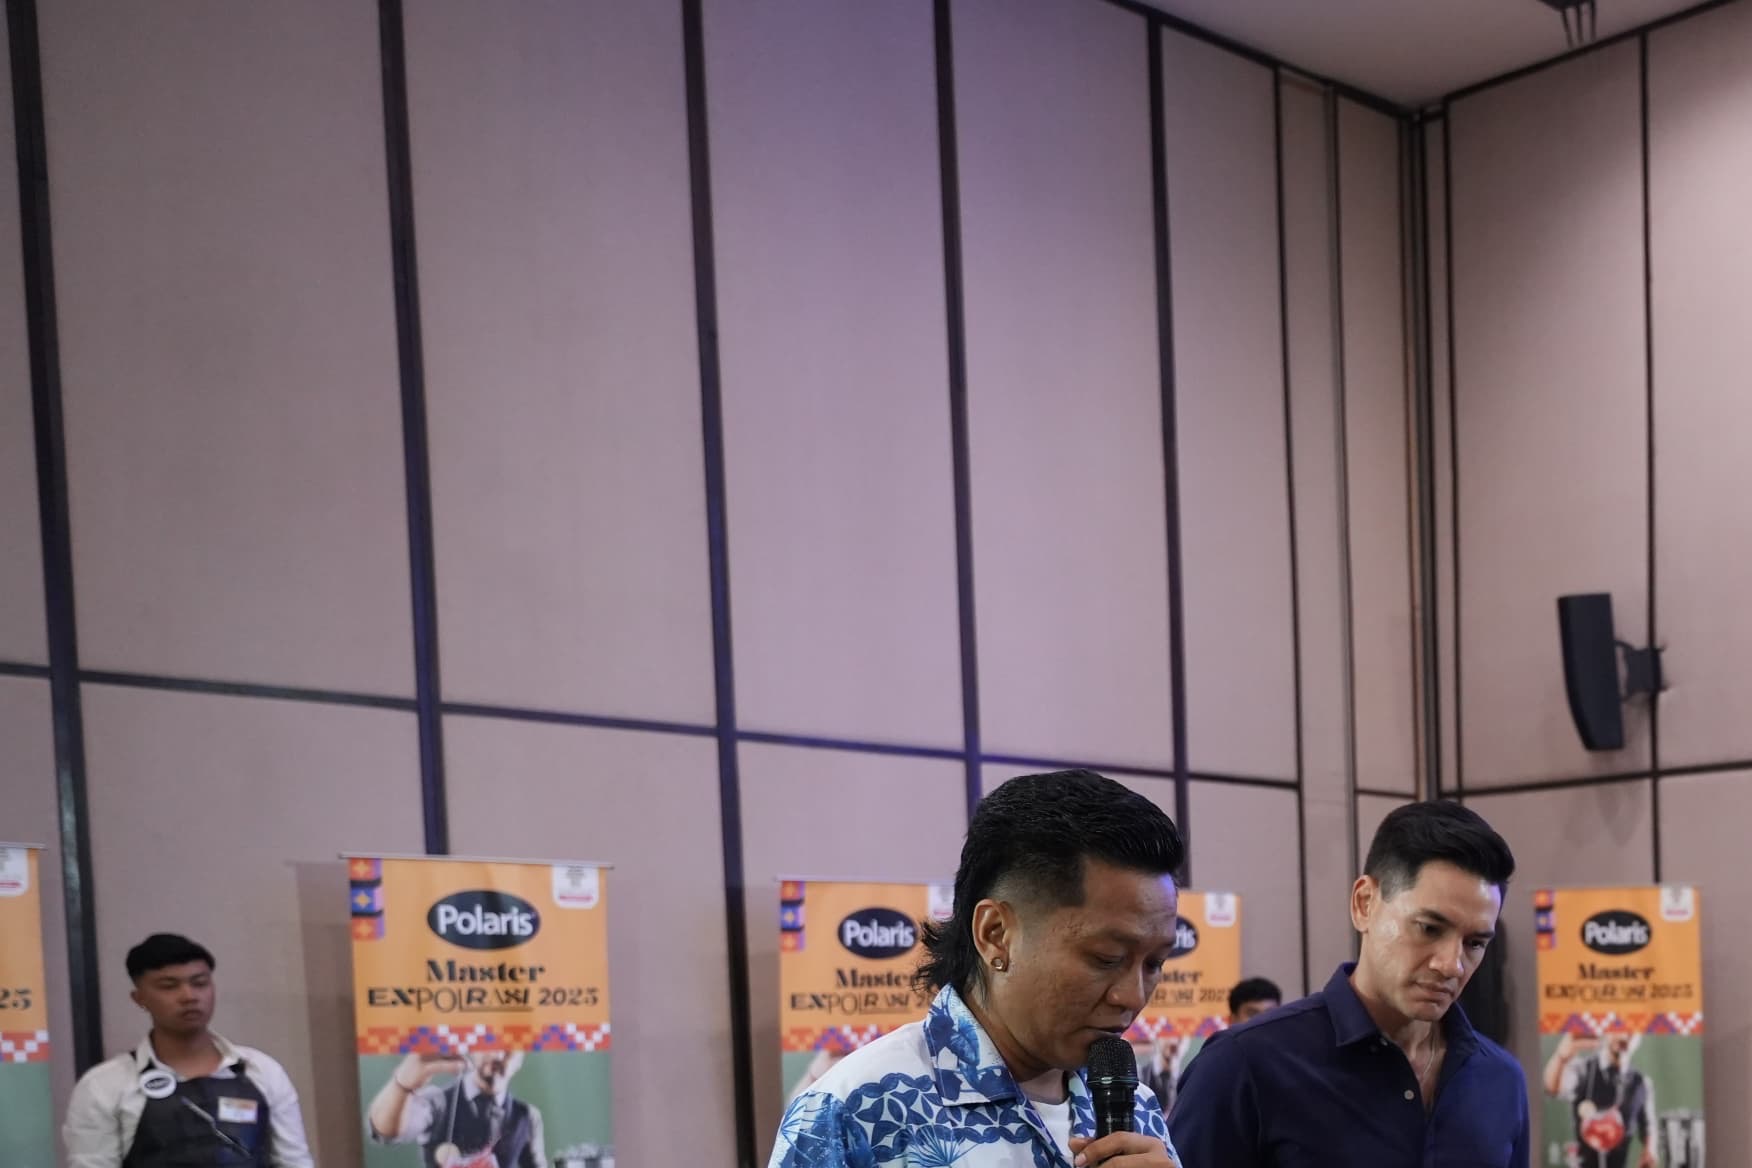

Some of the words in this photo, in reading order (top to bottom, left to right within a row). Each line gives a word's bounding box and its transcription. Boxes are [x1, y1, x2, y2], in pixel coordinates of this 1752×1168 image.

[437, 903, 534, 935] Polaris
[843, 919, 914, 947] Polaris
[1584, 918, 1649, 946] Polaris
[427, 959, 545, 983] Master
[1579, 963, 1655, 980] Master
[0, 987, 32, 1010] 25
[538, 987, 598, 1007] 2025
